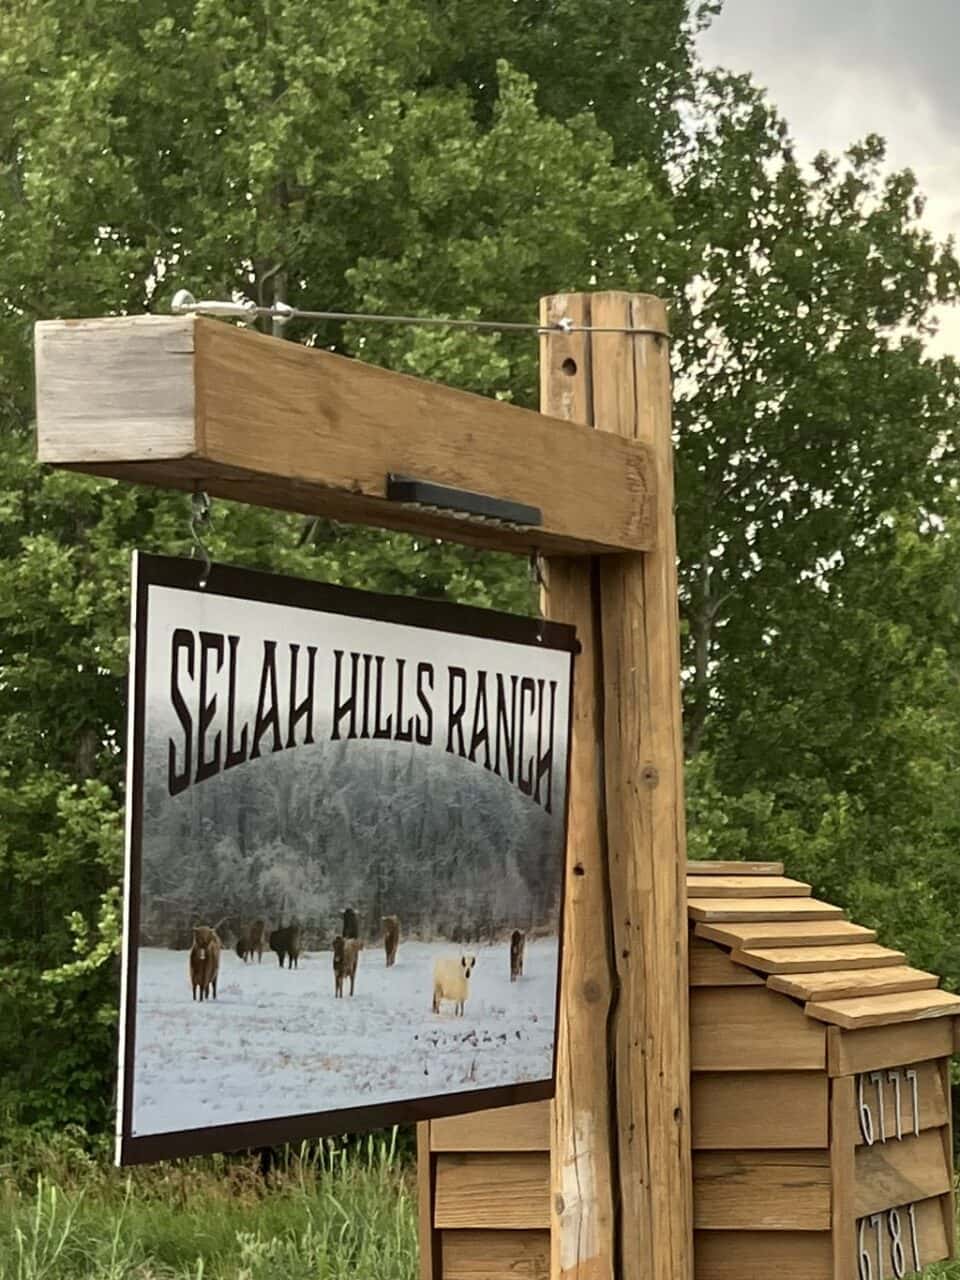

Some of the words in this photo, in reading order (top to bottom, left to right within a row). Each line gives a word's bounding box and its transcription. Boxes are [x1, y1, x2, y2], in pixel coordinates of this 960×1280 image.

[168, 628, 318, 796] SELAH
[330, 649, 434, 745] HILLS
[446, 666, 558, 815] RANCH
[858, 1070, 920, 1146] 6777
